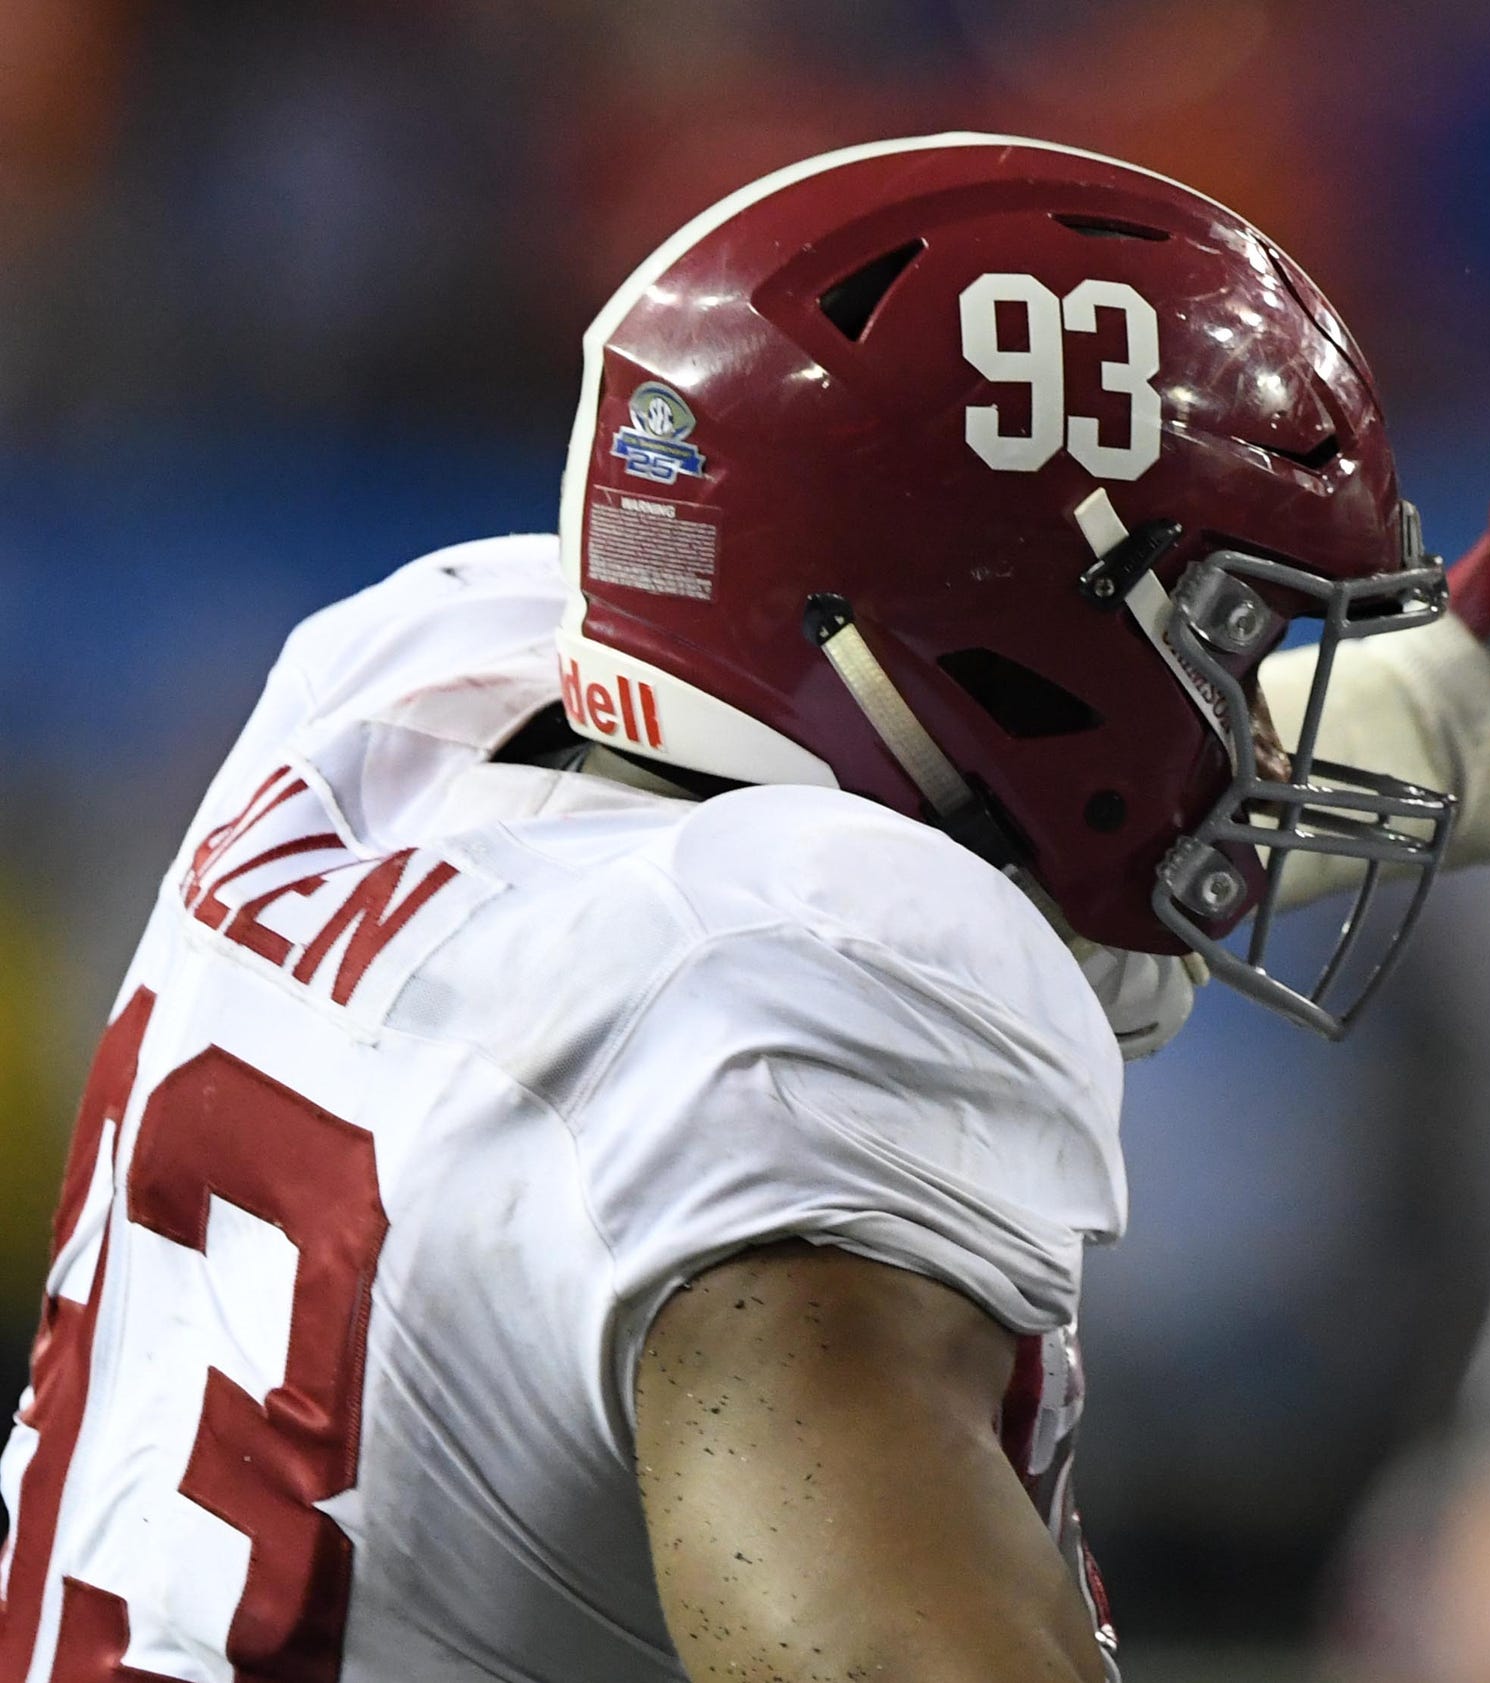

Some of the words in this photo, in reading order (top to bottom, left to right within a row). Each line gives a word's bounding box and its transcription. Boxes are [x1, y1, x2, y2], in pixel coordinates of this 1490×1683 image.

[958, 272, 1163, 481] 93
[628, 451, 674, 480] 25
[560, 658, 663, 749] dell
